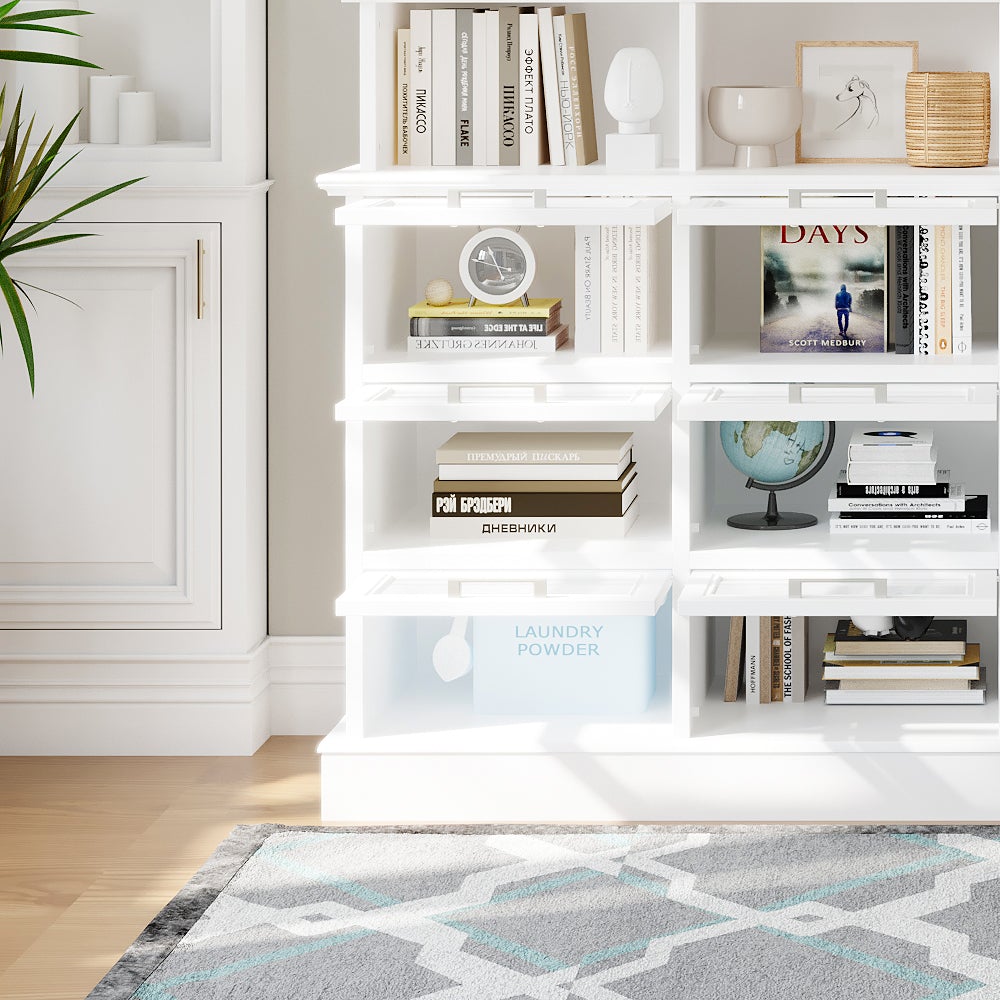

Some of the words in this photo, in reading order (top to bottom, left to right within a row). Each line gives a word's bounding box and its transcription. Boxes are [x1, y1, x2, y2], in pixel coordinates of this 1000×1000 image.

[524, 48, 534, 94] ЭФФЕКТ
[416, 89, 426, 134] ПИКАССО
[504, 86, 514, 147] ПИКАССО
[524, 97, 534, 134] ПЛАТО
[460, 120, 470, 146] FLAKE
[780, 225, 868, 244] DAYS
[789, 339, 818, 347] SCOTT
[822, 339, 866, 347] MEDBURY
[436, 494, 456, 512] РЭЙ
[460, 497, 512, 514] БРЭДБЕРИ
[482, 524, 556, 534] ДНЕВНИКИ
[516, 626, 604, 638] LAUNDRY
[785, 636, 792, 646] OF
[518, 644, 600, 656] POWDER
